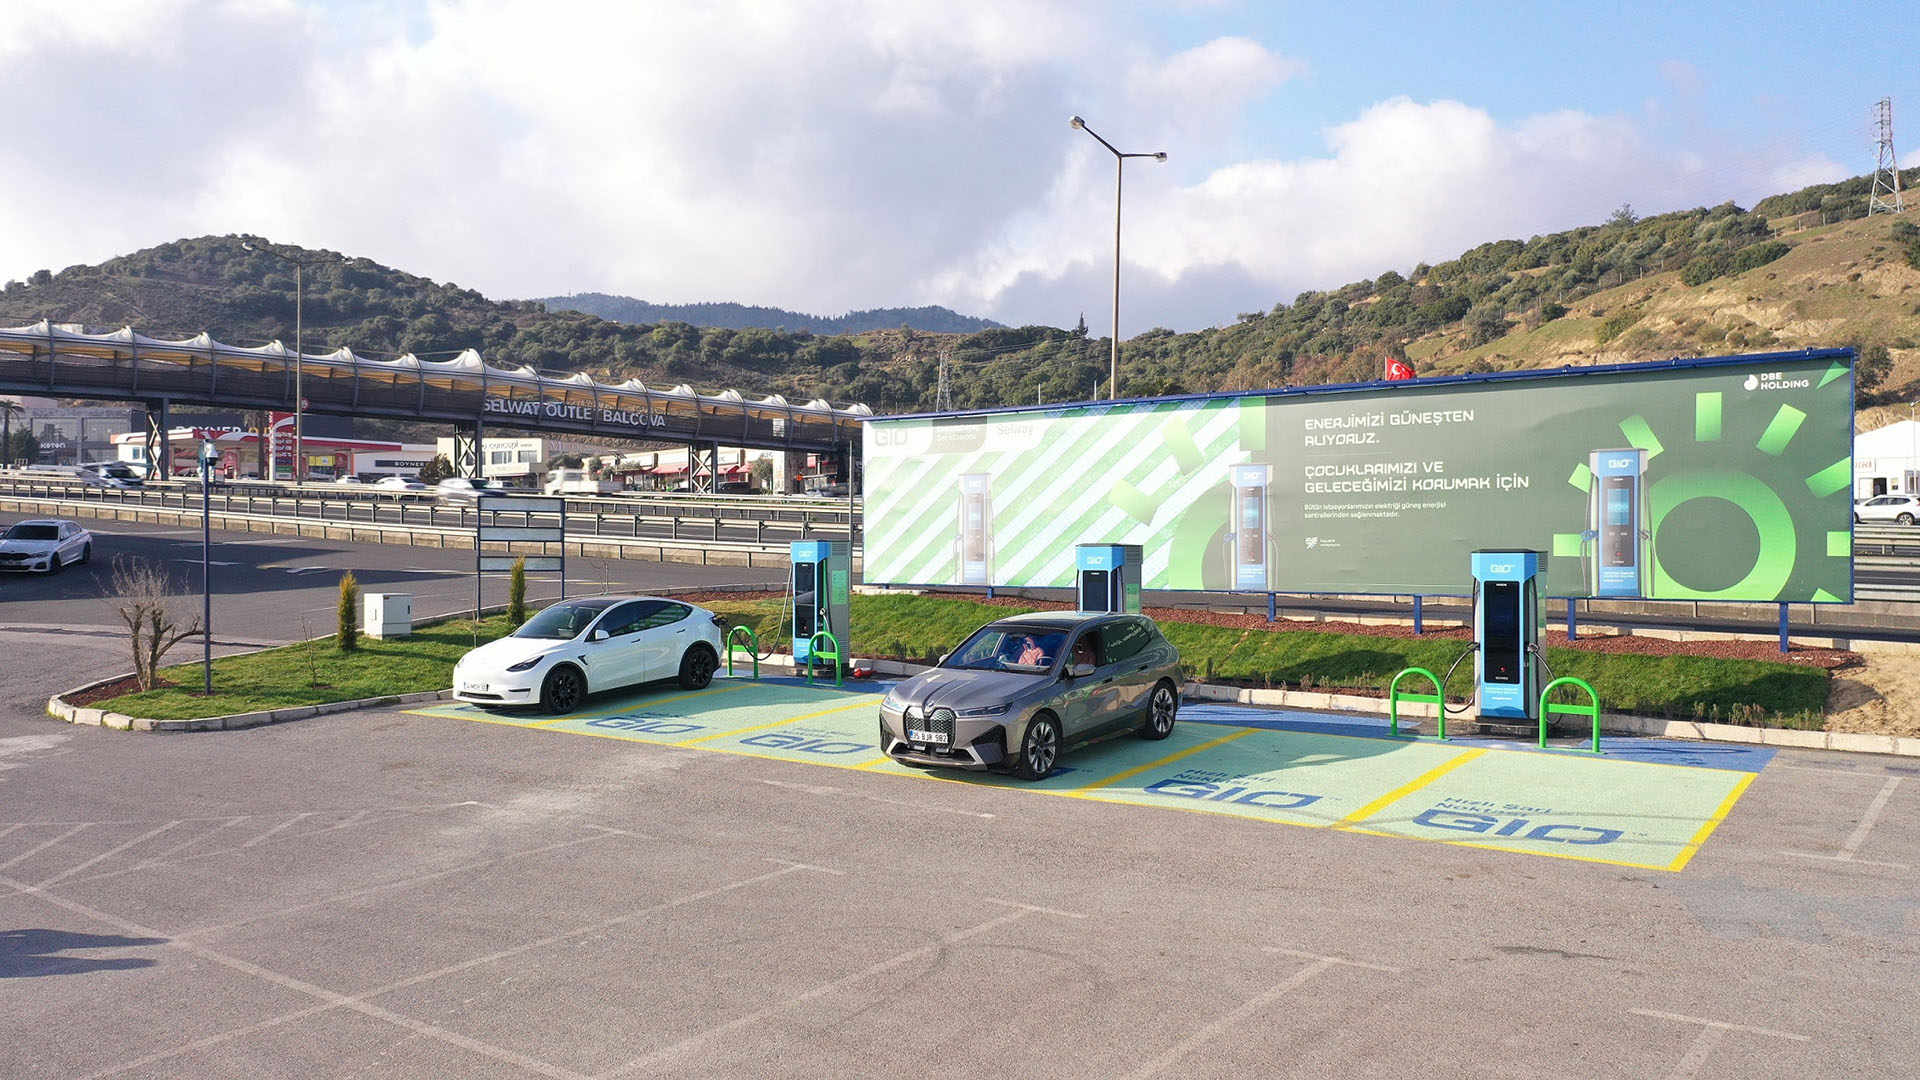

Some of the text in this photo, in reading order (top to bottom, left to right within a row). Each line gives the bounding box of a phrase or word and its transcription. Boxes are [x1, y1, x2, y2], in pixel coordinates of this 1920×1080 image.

[1761, 372, 1782, 381] DBE
[1761, 379, 1809, 390] HOLDING
[546, 403, 597, 420] OUTLE
[1304, 409, 1474, 430] ENERJİMİZİ GÜNEŞTEN
[1304, 461, 1444, 480] ÇOCUKLARIMIZI VE
[1304, 472, 1530, 494] GELECEĞİMİZİ KORUMAK İÇİN
[739, 733, 876, 754] GIO
[1144, 779, 1324, 808] GIO
[1412, 808, 1625, 845] GIO
